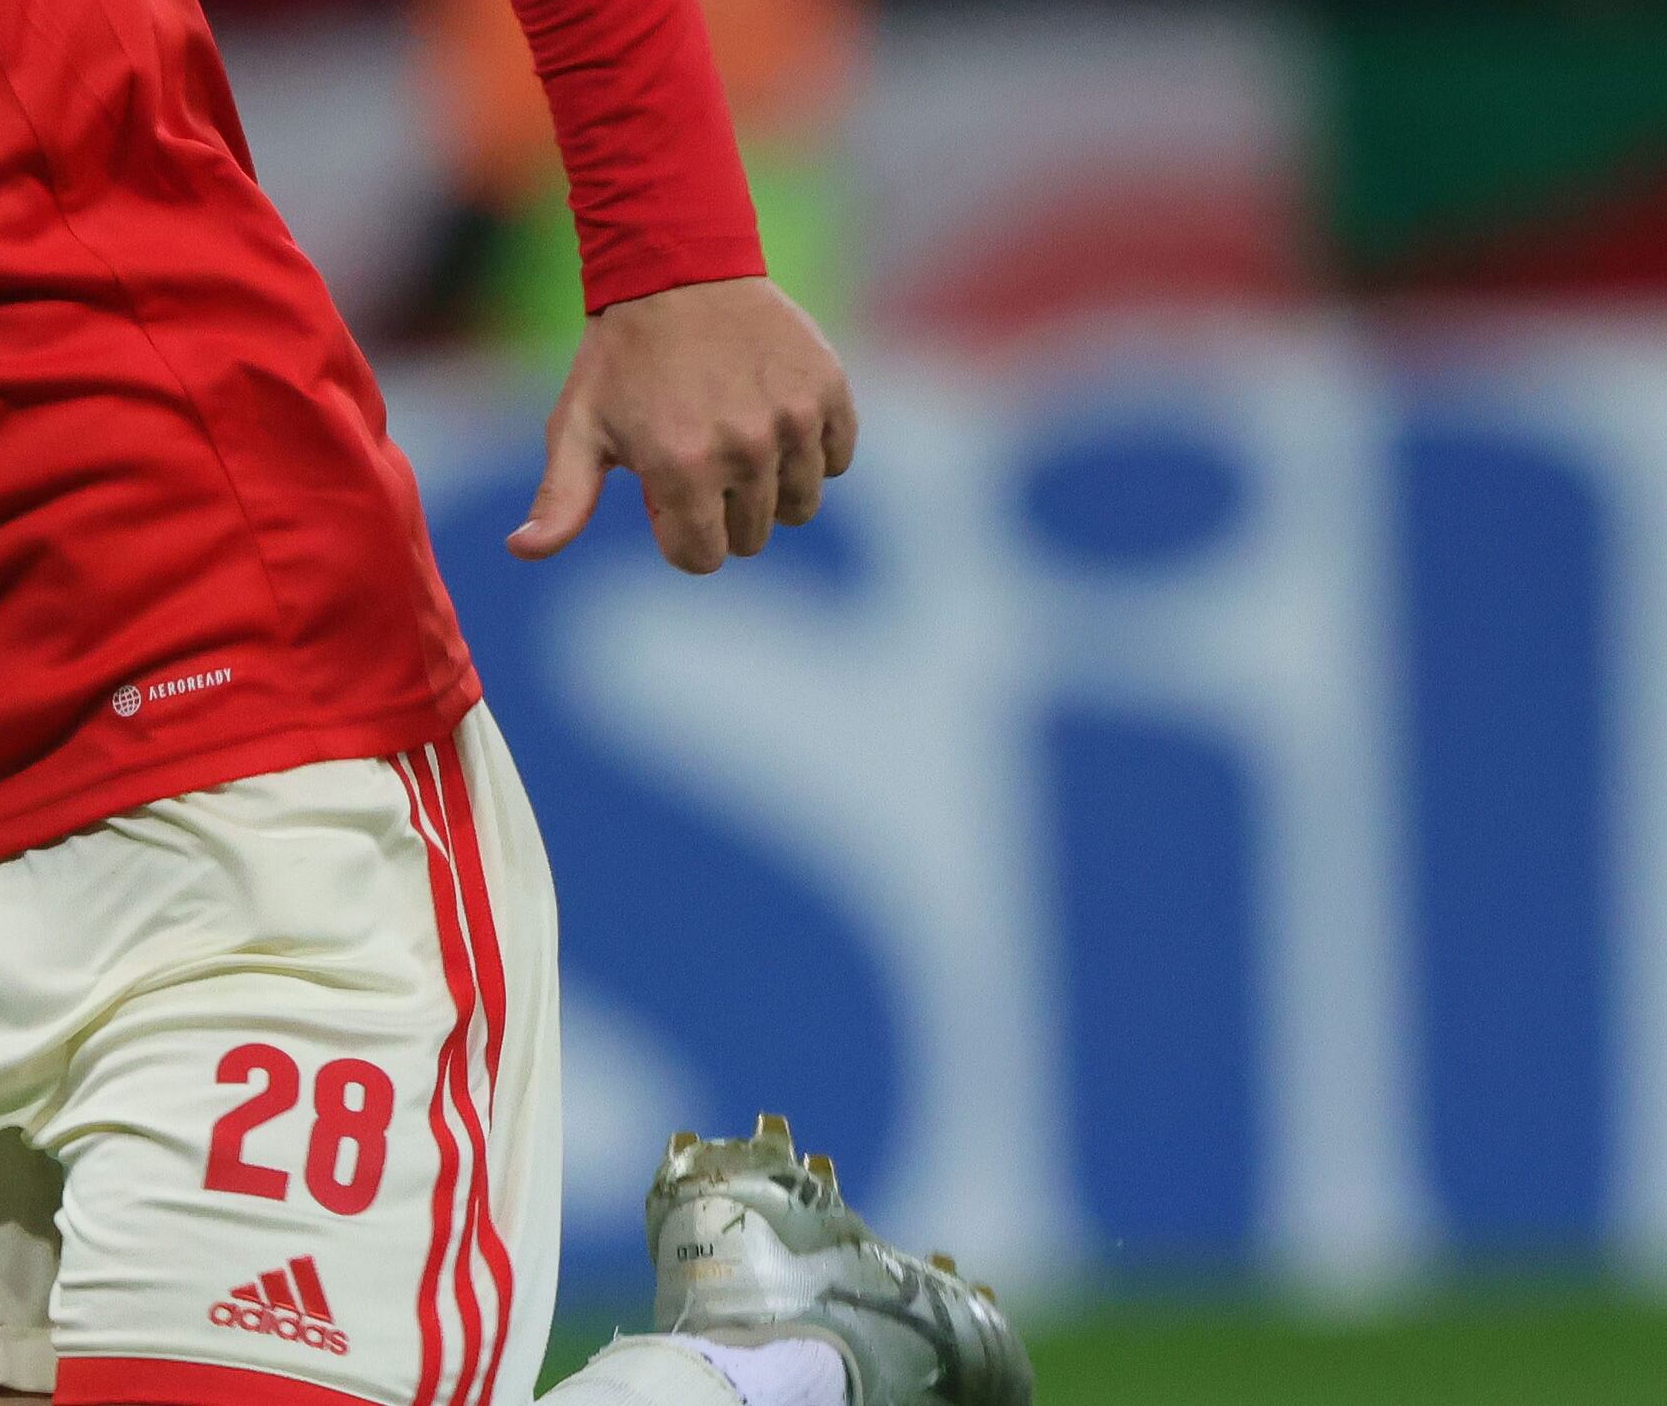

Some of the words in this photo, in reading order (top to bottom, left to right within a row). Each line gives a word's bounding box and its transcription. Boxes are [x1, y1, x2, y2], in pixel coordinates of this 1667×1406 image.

[149, 668, 232, 701] AEROREADY
[203, 1043, 395, 1216] 28
[210, 1297, 350, 1358] adidas
